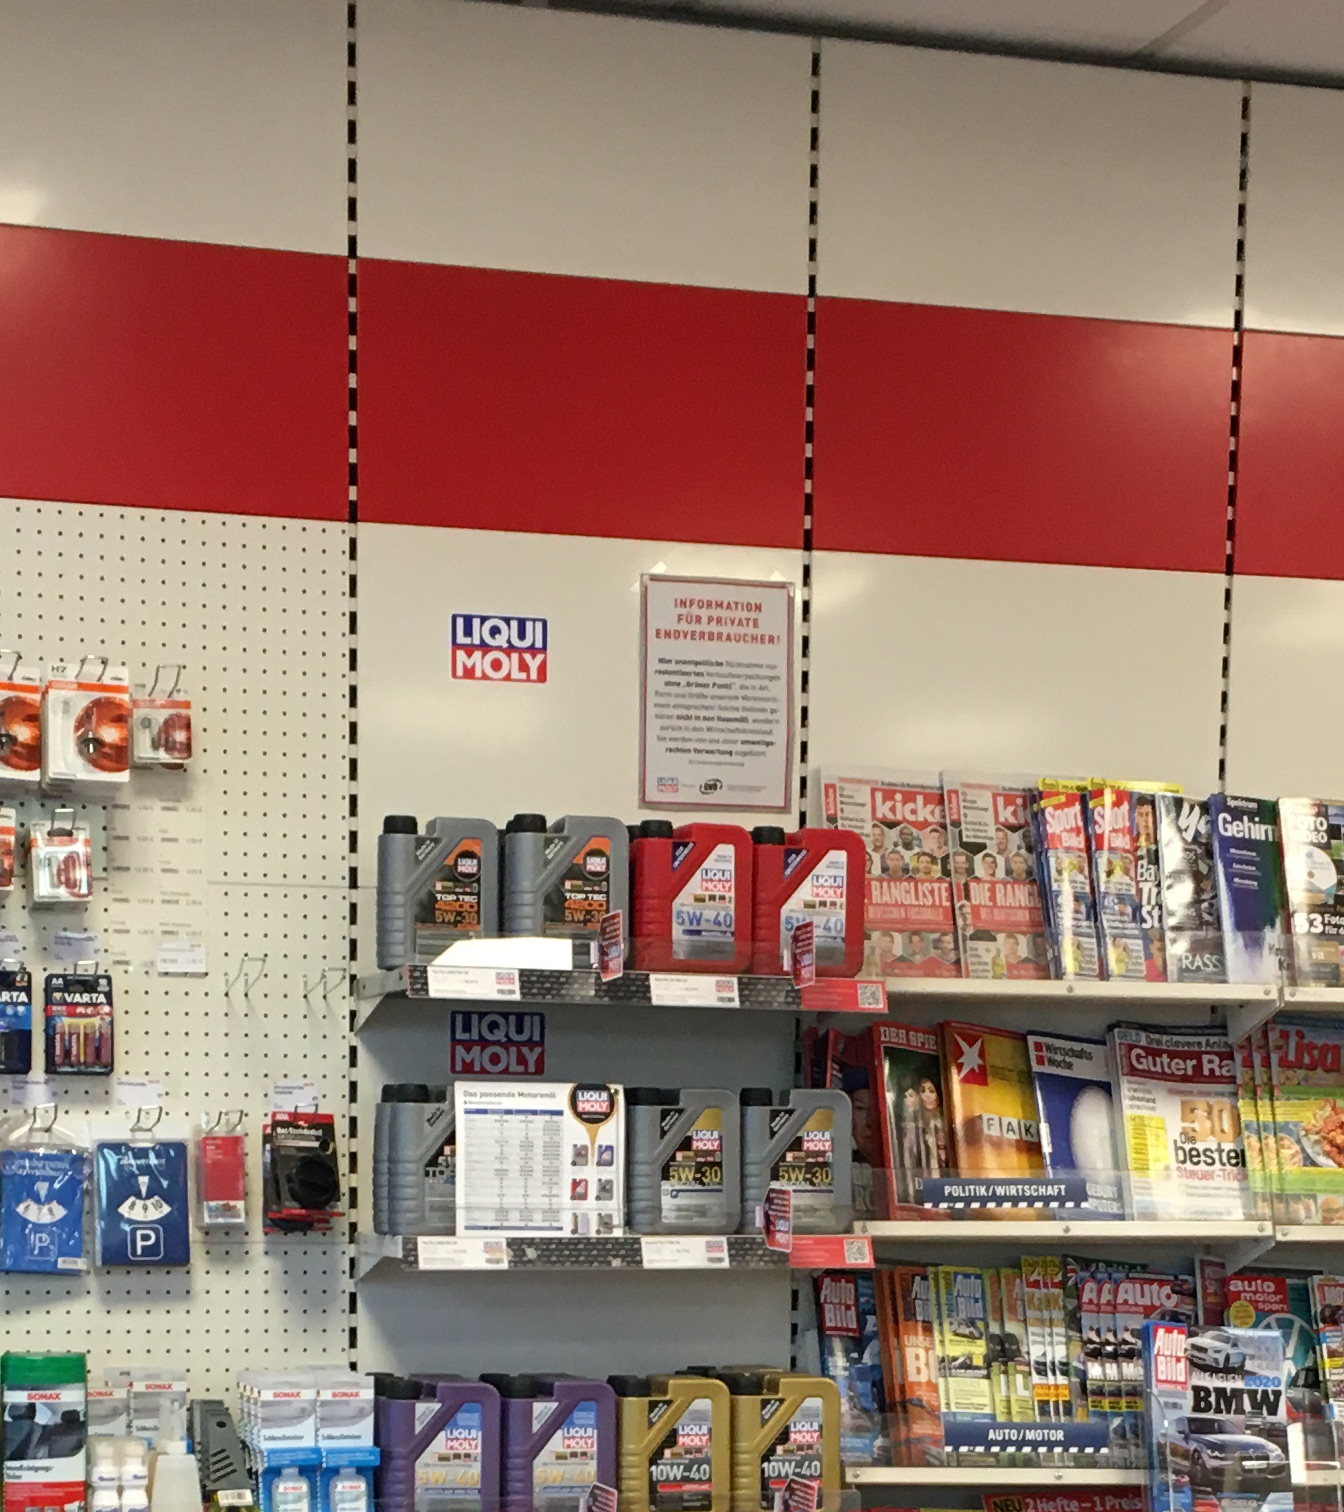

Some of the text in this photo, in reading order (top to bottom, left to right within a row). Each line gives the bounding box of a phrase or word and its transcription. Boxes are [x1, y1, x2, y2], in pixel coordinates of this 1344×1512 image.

[674, 598, 762, 612] INFORMATION
[677, 613, 759, 629] FÜR PRIVATE
[456, 615, 543, 650] LIQUI
[655, 628, 781, 645] ENDVERBRAUCHER!
[456, 649, 547, 681] MOLY
[702, 869, 731, 881] LIQUI
[813, 875, 843, 887] LIQUI
[702, 880, 732, 892] MOLY
[813, 886, 844, 898] MOLY
[871, 880, 950, 907] RANGLISTE
[970, 882, 993, 905] DIE
[435, 910, 478, 923] 5W-30
[675, 909, 734, 929] 5W-40
[63, 992, 107, 1005] VARTA
[456, 1013, 541, 1043] LIQUI
[456, 1044, 544, 1073] MOLY
[1280, 1033, 1340, 1073] Lisa
[1130, 1047, 1235, 1079] Guter Ra
[577, 1090, 609, 1102] LIQUI
[577, 1101, 610, 1114] MOLY
[692, 1130, 720, 1140] LIQUI
[804, 1131, 832, 1141] LIQUI
[692, 1140, 720, 1151] MOLY
[804, 1141, 832, 1152] MOLY
[669, 1166, 721, 1184] 5W-30
[778, 1166, 833, 1184] 5W-30
[944, 1182, 1066, 1199] POLITIK/WIRTSCHAFT
[133, 1227, 156, 1260] P
[1230, 1279, 1276, 1293] auto
[1240, 1291, 1284, 1304] motor
[1155, 1326, 1187, 1357] Auto
[1156, 1355, 1187, 1387] Bild
[1245, 1374, 1282, 1388] 2020
[26, 1392, 62, 1401] SONAX
[272, 1391, 301, 1399] SONAX
[331, 1391, 361, 1399] SONAX
[1191, 1388, 1281, 1416] BMW
[446, 1428, 478, 1439] LIQUI
[678, 1424, 708, 1435] LIQUI
[988, 1427, 1065, 1443] AUTO/MOTOR
[446, 1439, 478, 1450] MOLY
[678, 1435, 709, 1446] MOLY
[650, 1463, 710, 1481] 10W-40
[761, 1460, 821, 1479] 10W-40
